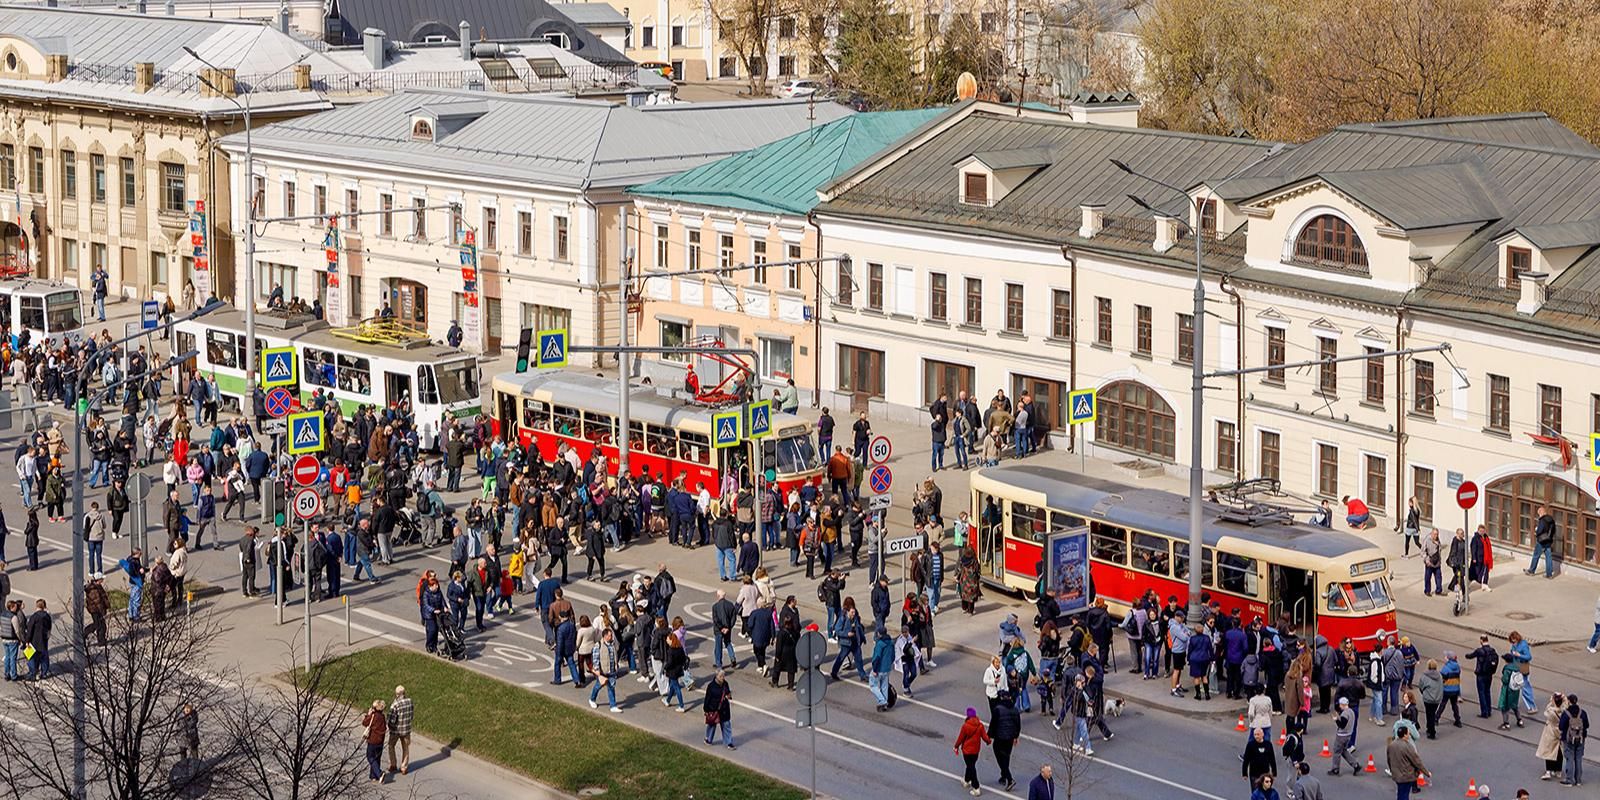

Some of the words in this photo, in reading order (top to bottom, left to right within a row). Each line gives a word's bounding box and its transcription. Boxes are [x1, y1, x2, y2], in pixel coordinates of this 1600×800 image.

[875, 444, 887, 457] 50
[300, 496, 315, 510] 50
[890, 538, 917, 551] СТОП
